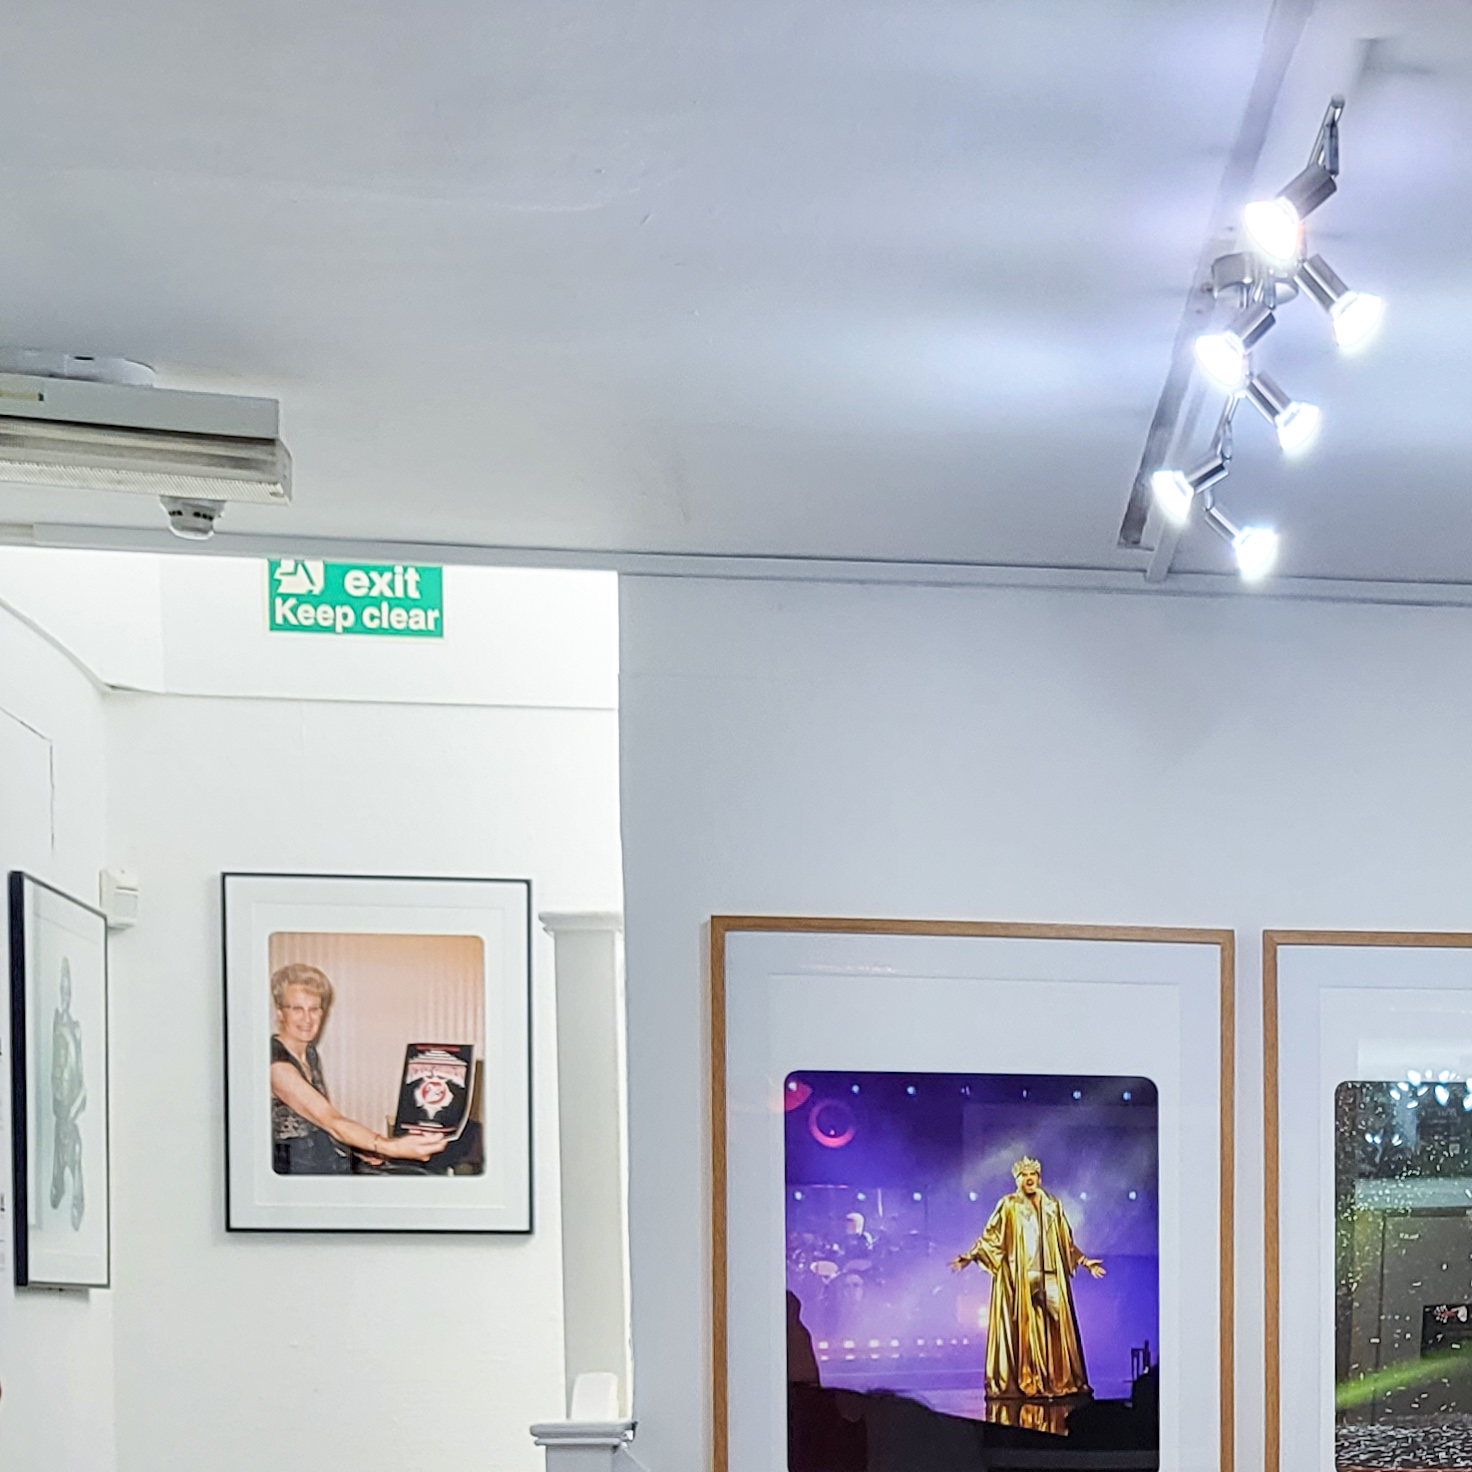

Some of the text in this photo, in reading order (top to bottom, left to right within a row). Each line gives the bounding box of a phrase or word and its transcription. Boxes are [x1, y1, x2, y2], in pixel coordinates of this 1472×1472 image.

[344, 565, 421, 599] exit
[275, 597, 440, 633] Keep clear
